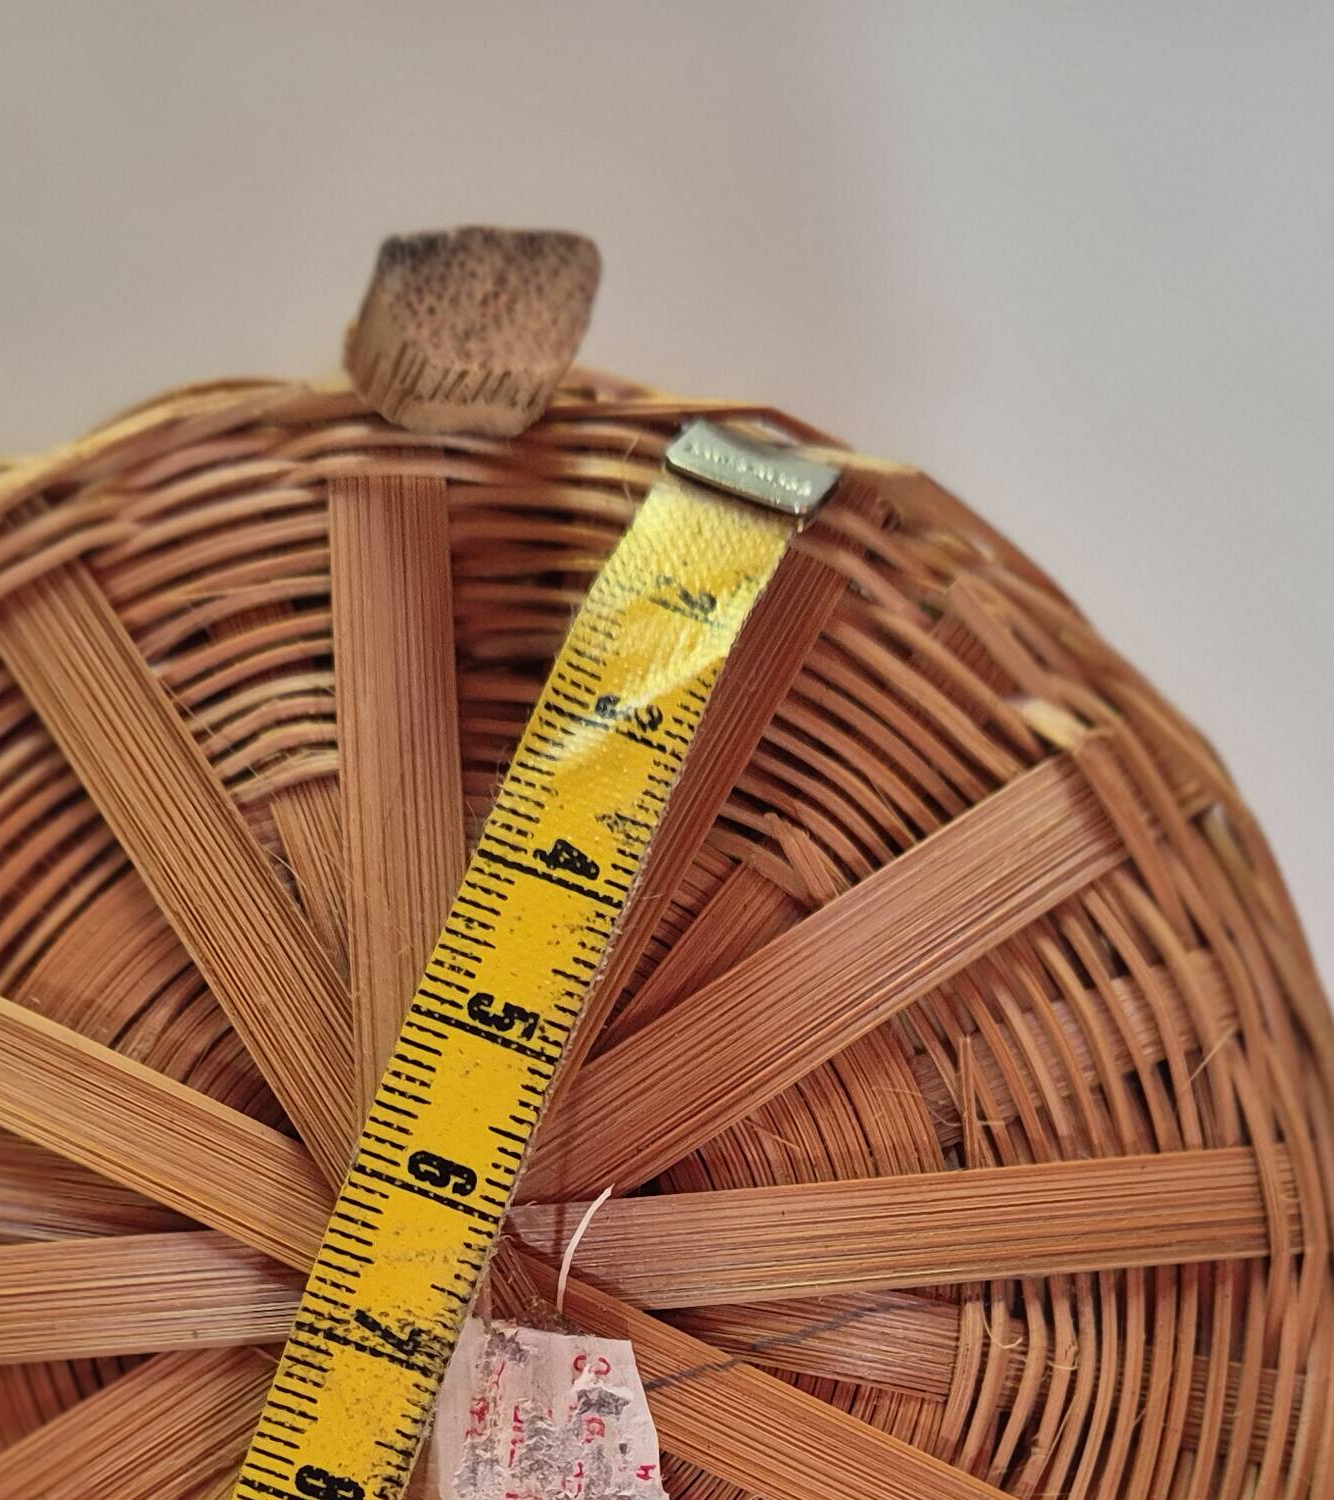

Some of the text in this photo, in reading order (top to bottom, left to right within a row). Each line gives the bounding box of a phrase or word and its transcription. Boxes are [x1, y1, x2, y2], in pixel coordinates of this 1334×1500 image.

[595, 694, 663, 731] 3
[533, 838, 600, 880] 4
[467, 992, 540, 1041] 5
[407, 1150, 478, 1196] 6
[354, 1308, 424, 1355] 7
